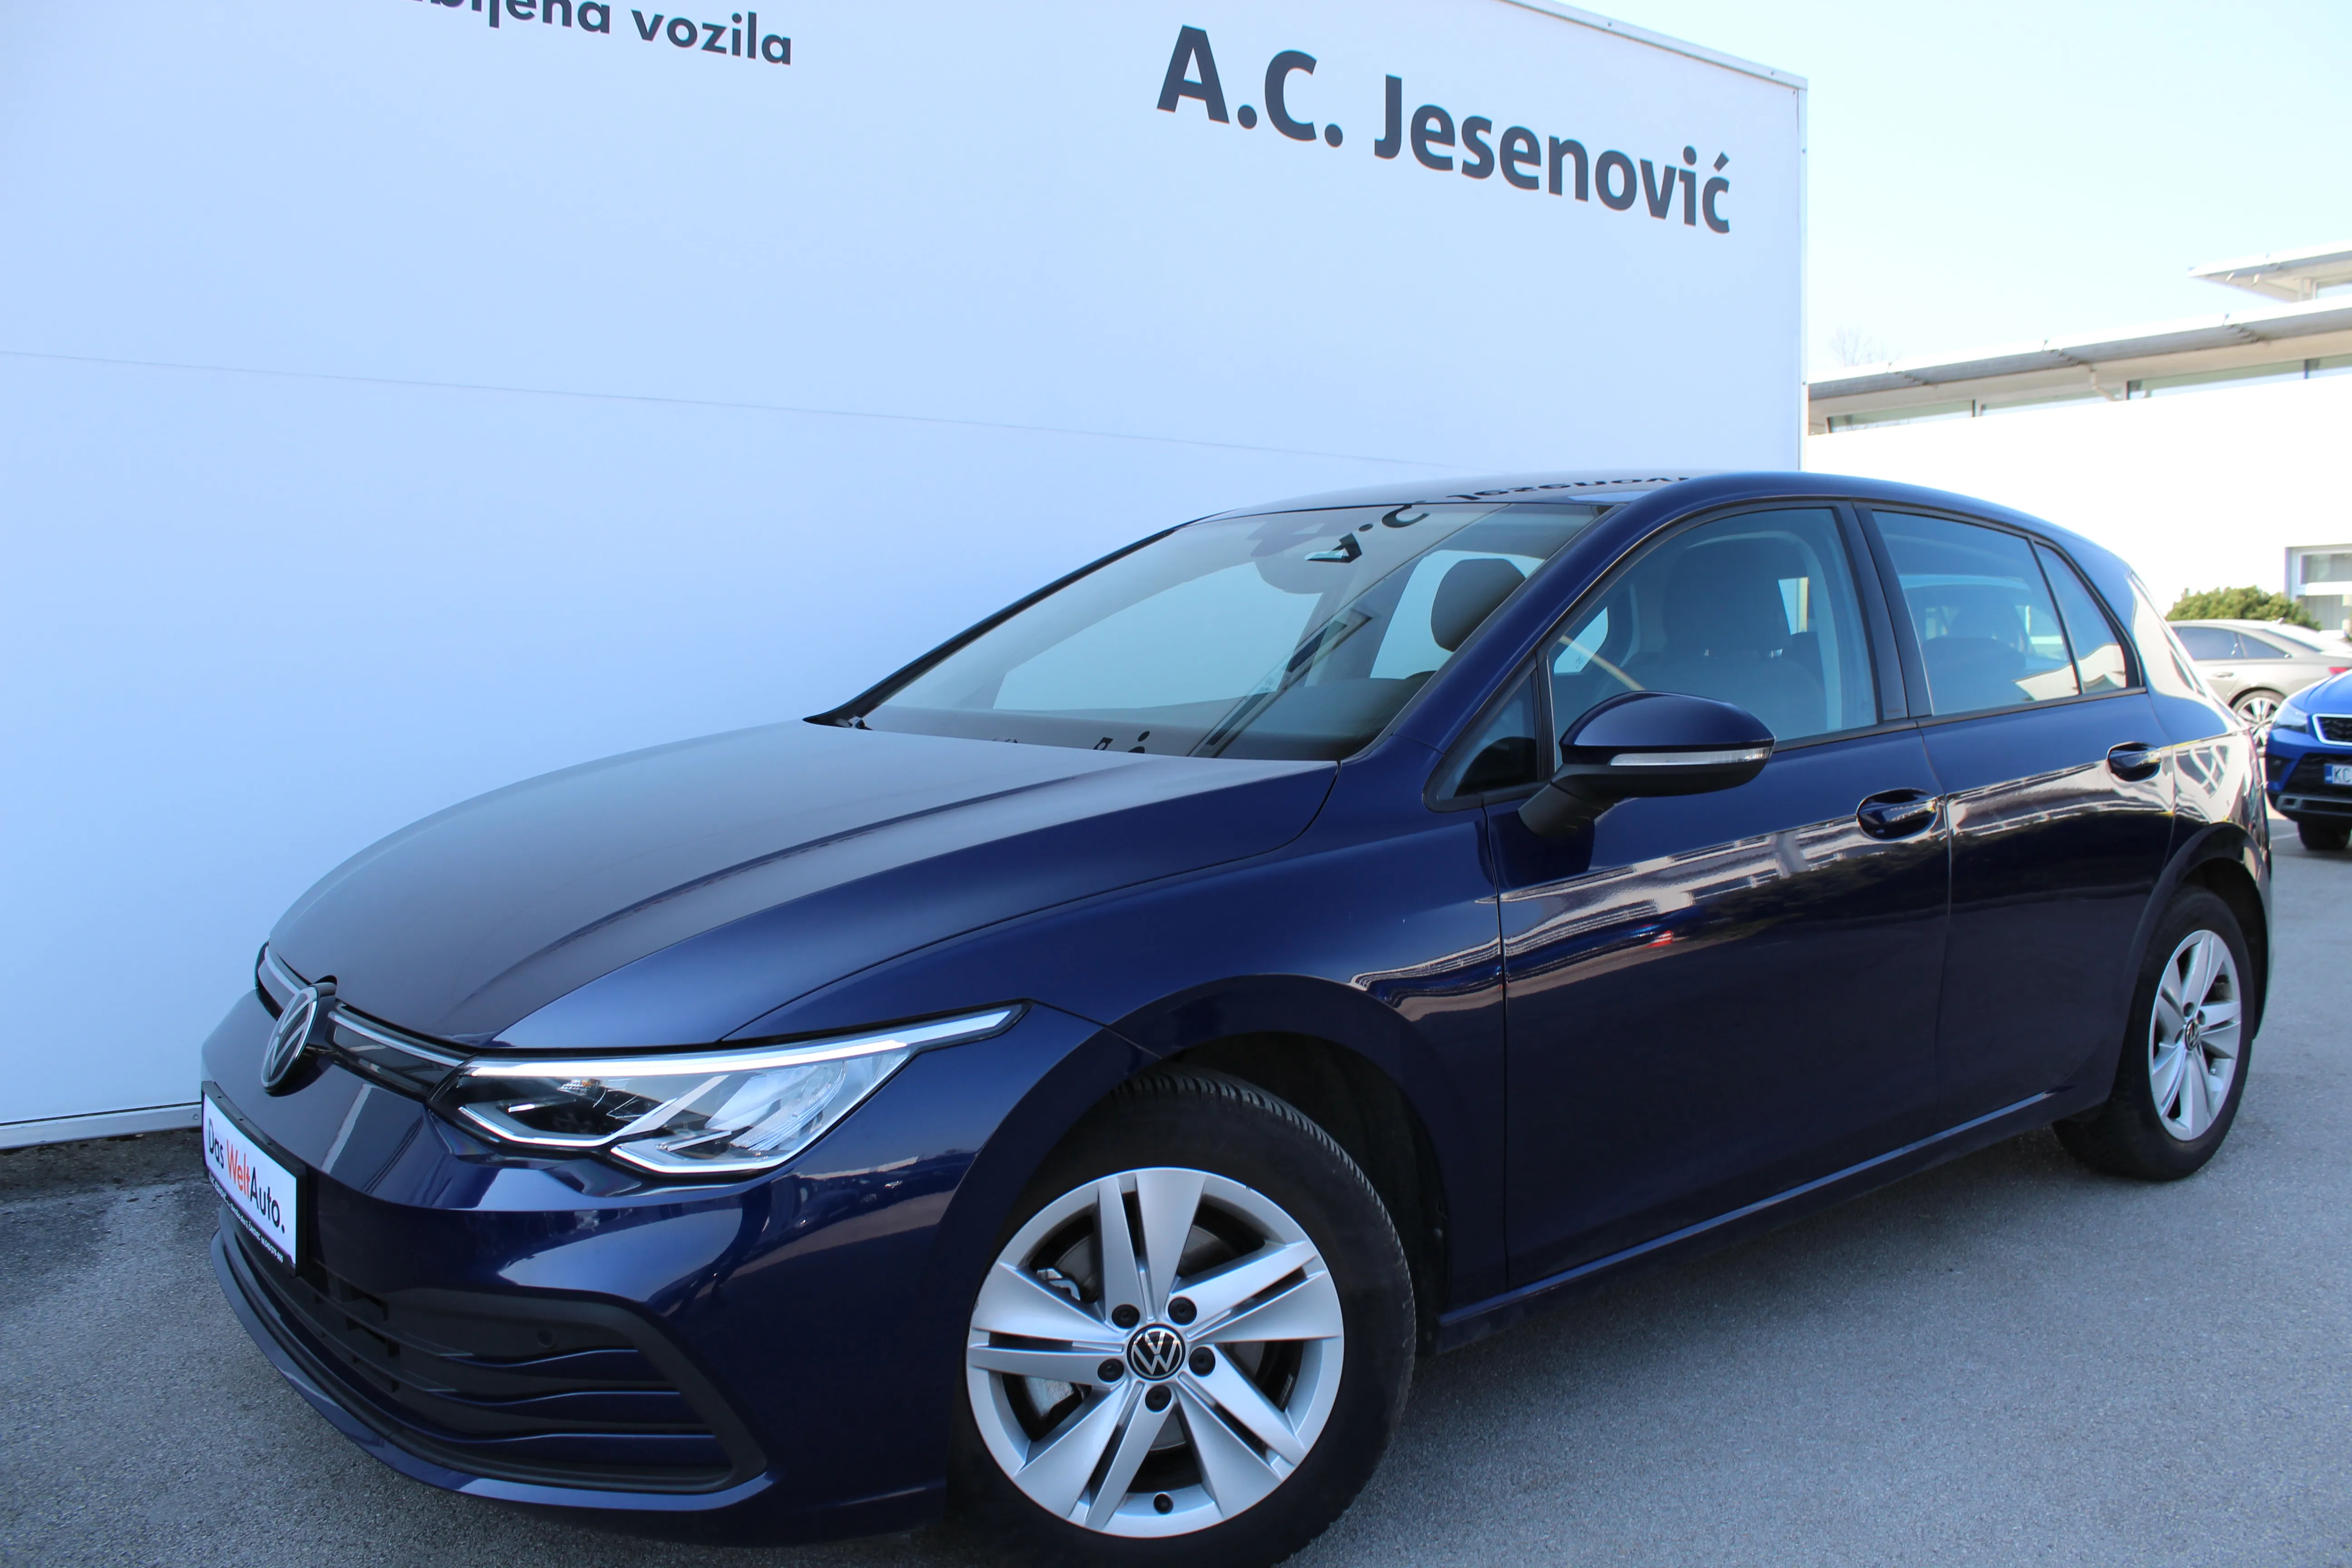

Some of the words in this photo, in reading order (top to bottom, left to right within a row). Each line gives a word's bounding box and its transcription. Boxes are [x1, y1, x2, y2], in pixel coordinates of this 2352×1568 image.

[632, 10, 791, 65] vozila
[1157, 25, 1343, 148] A.C.
[1374, 74, 1730, 233] Jesenović
[209, 1117, 224, 1169] Das
[226, 1139, 285, 1234] WeltAuto.
